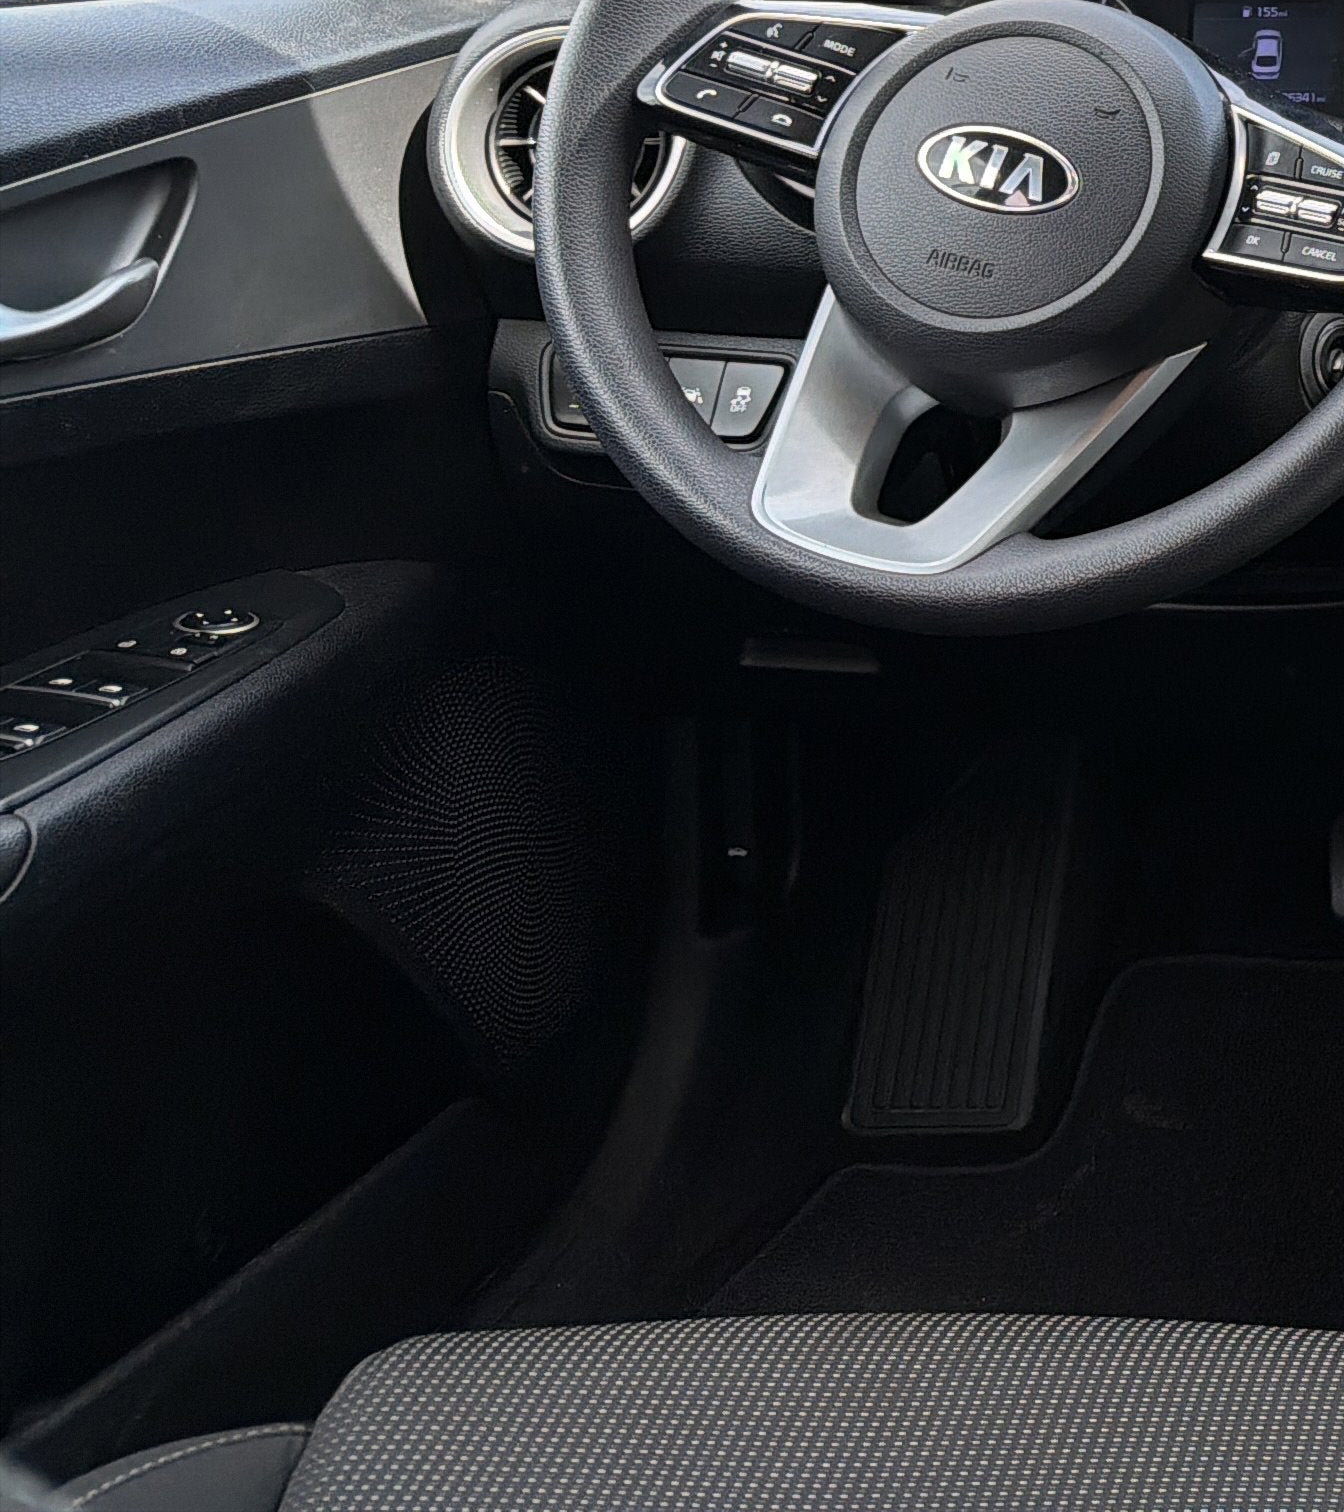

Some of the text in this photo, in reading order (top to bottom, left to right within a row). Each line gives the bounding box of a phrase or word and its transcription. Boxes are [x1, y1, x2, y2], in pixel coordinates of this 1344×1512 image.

[823, 38, 856, 57] MODE
[938, 135, 1044, 202] KIA
[1310, 165, 1344, 180] CRUISE
[1301, 246, 1337, 262] CANCEL
[925, 248, 995, 278] AIRBAG
[730, 402, 747, 412] OFF
